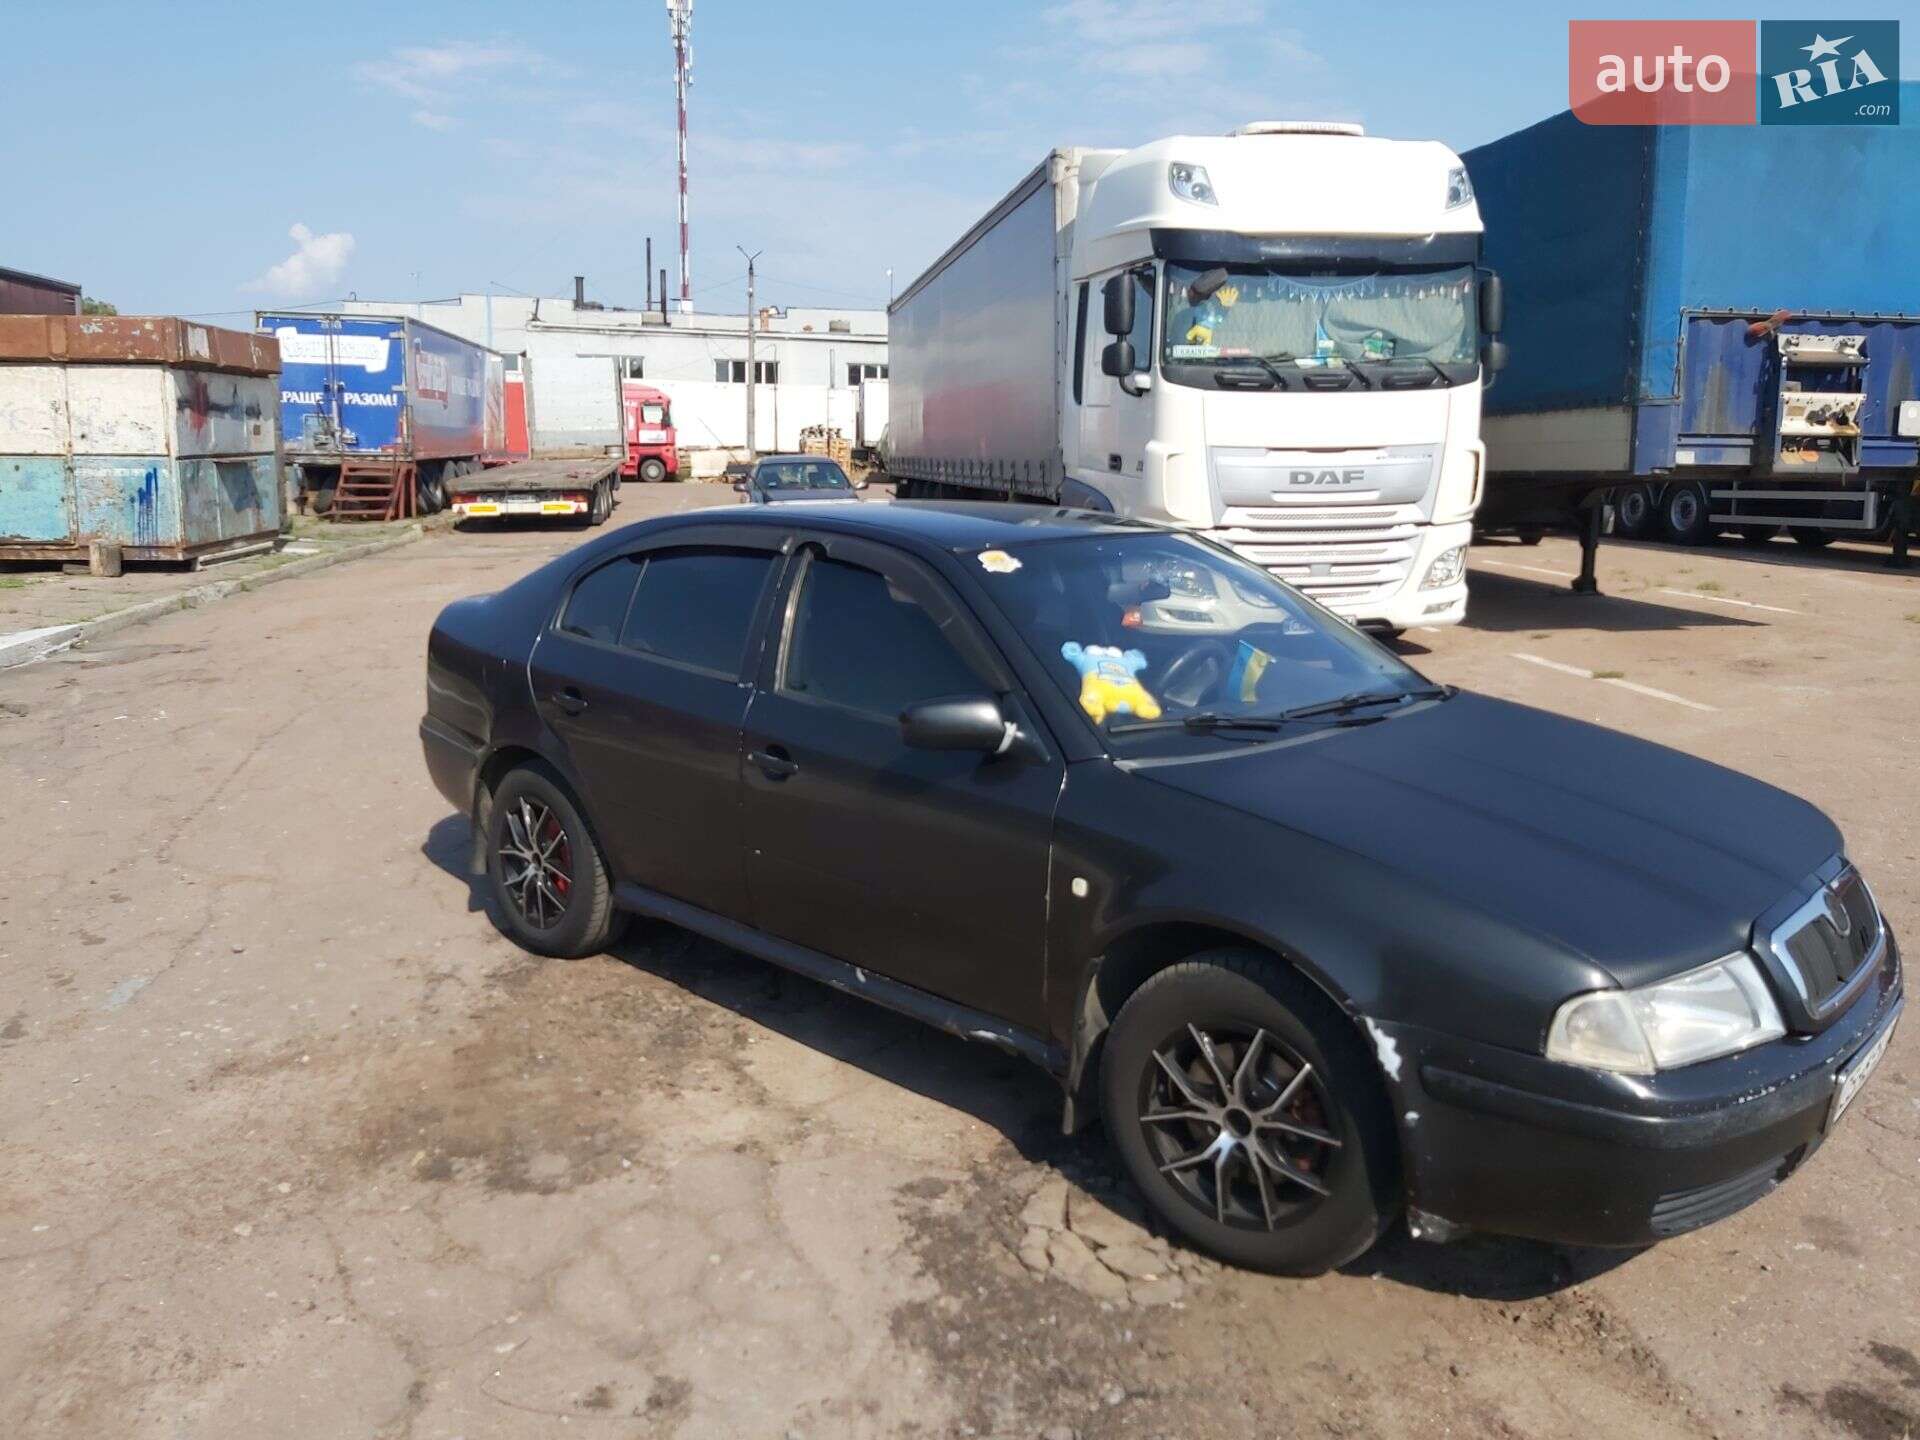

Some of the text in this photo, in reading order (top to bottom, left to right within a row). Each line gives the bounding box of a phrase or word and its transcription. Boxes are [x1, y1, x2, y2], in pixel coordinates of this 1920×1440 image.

[280, 390, 398, 407] РАЩЕ РАЗОМ!
[1289, 470, 1365, 485] DAF
